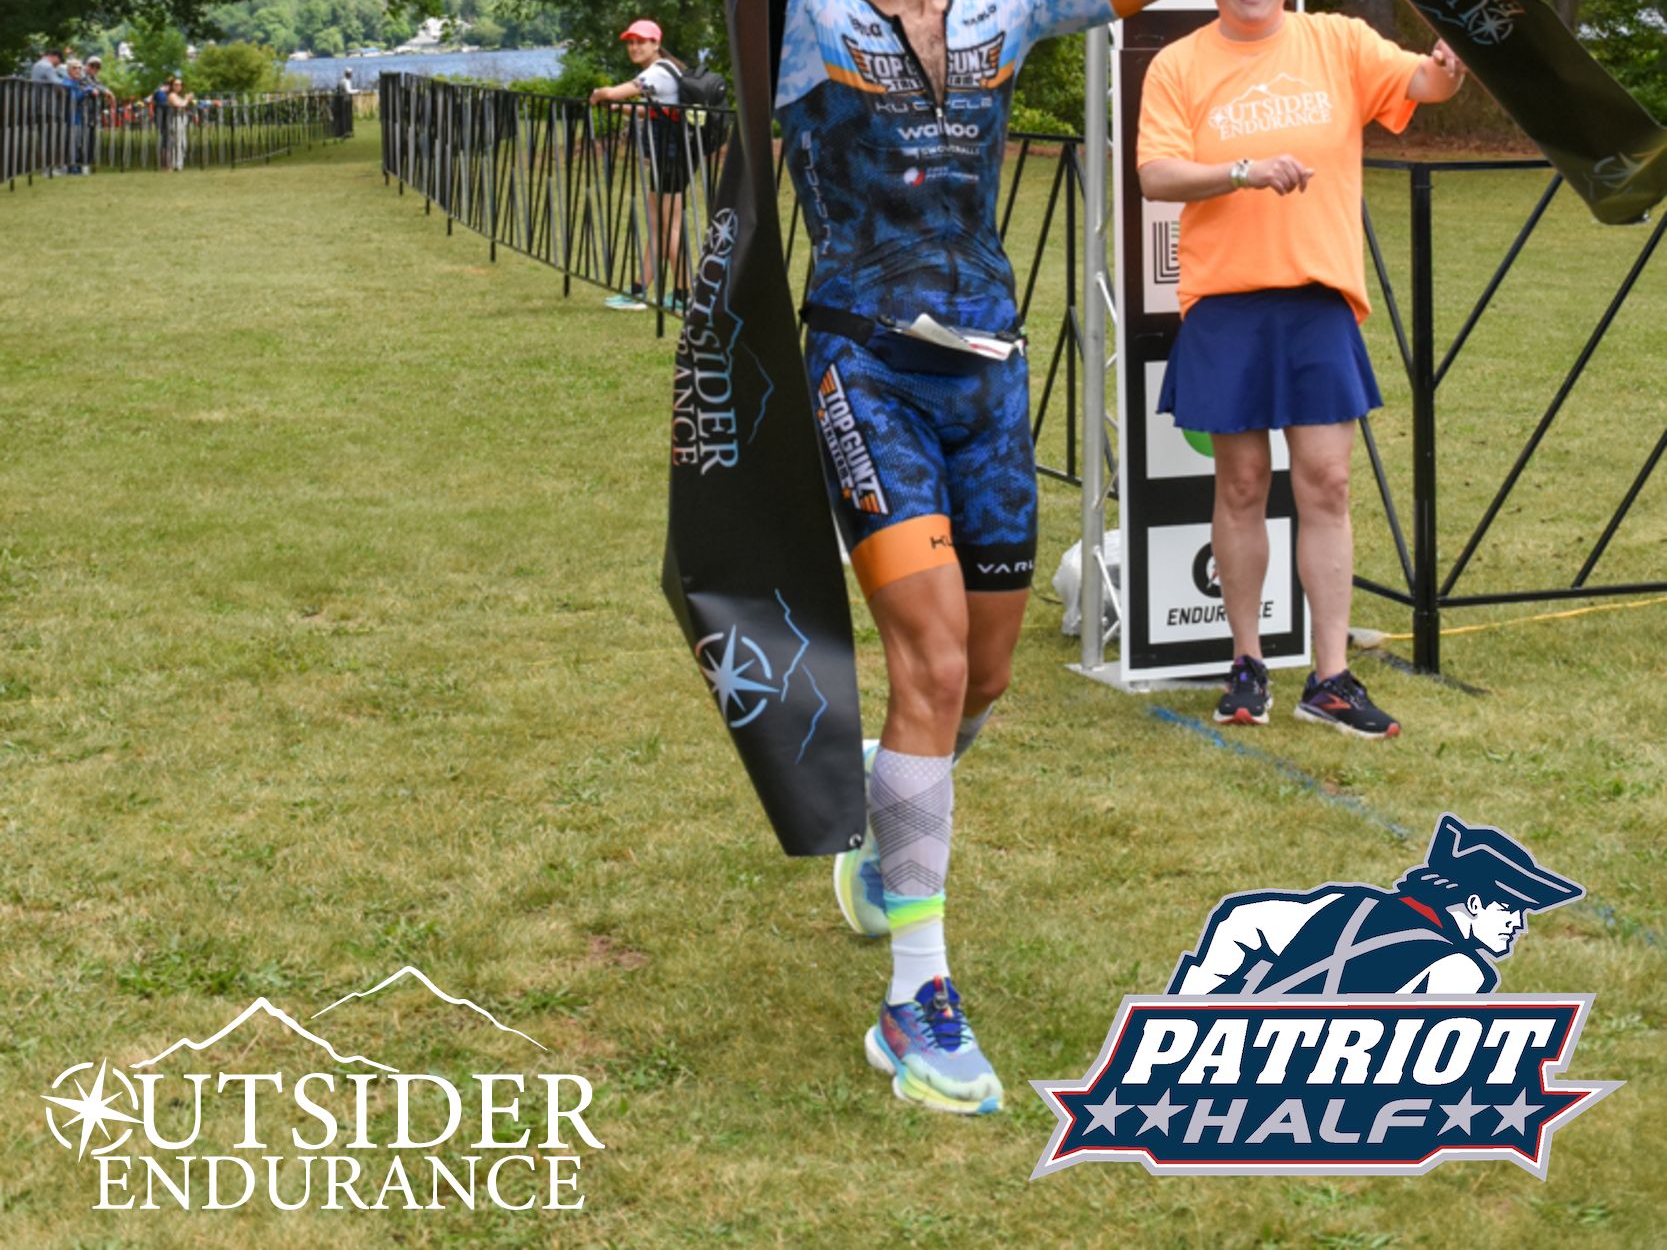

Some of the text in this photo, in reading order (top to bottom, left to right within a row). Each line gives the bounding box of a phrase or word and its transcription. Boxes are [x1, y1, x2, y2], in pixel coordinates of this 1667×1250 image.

[912, 96, 993, 111] CCLE
[1219, 109, 1331, 141] ENDURANCE
[1167, 600, 1274, 627] ENDURE
